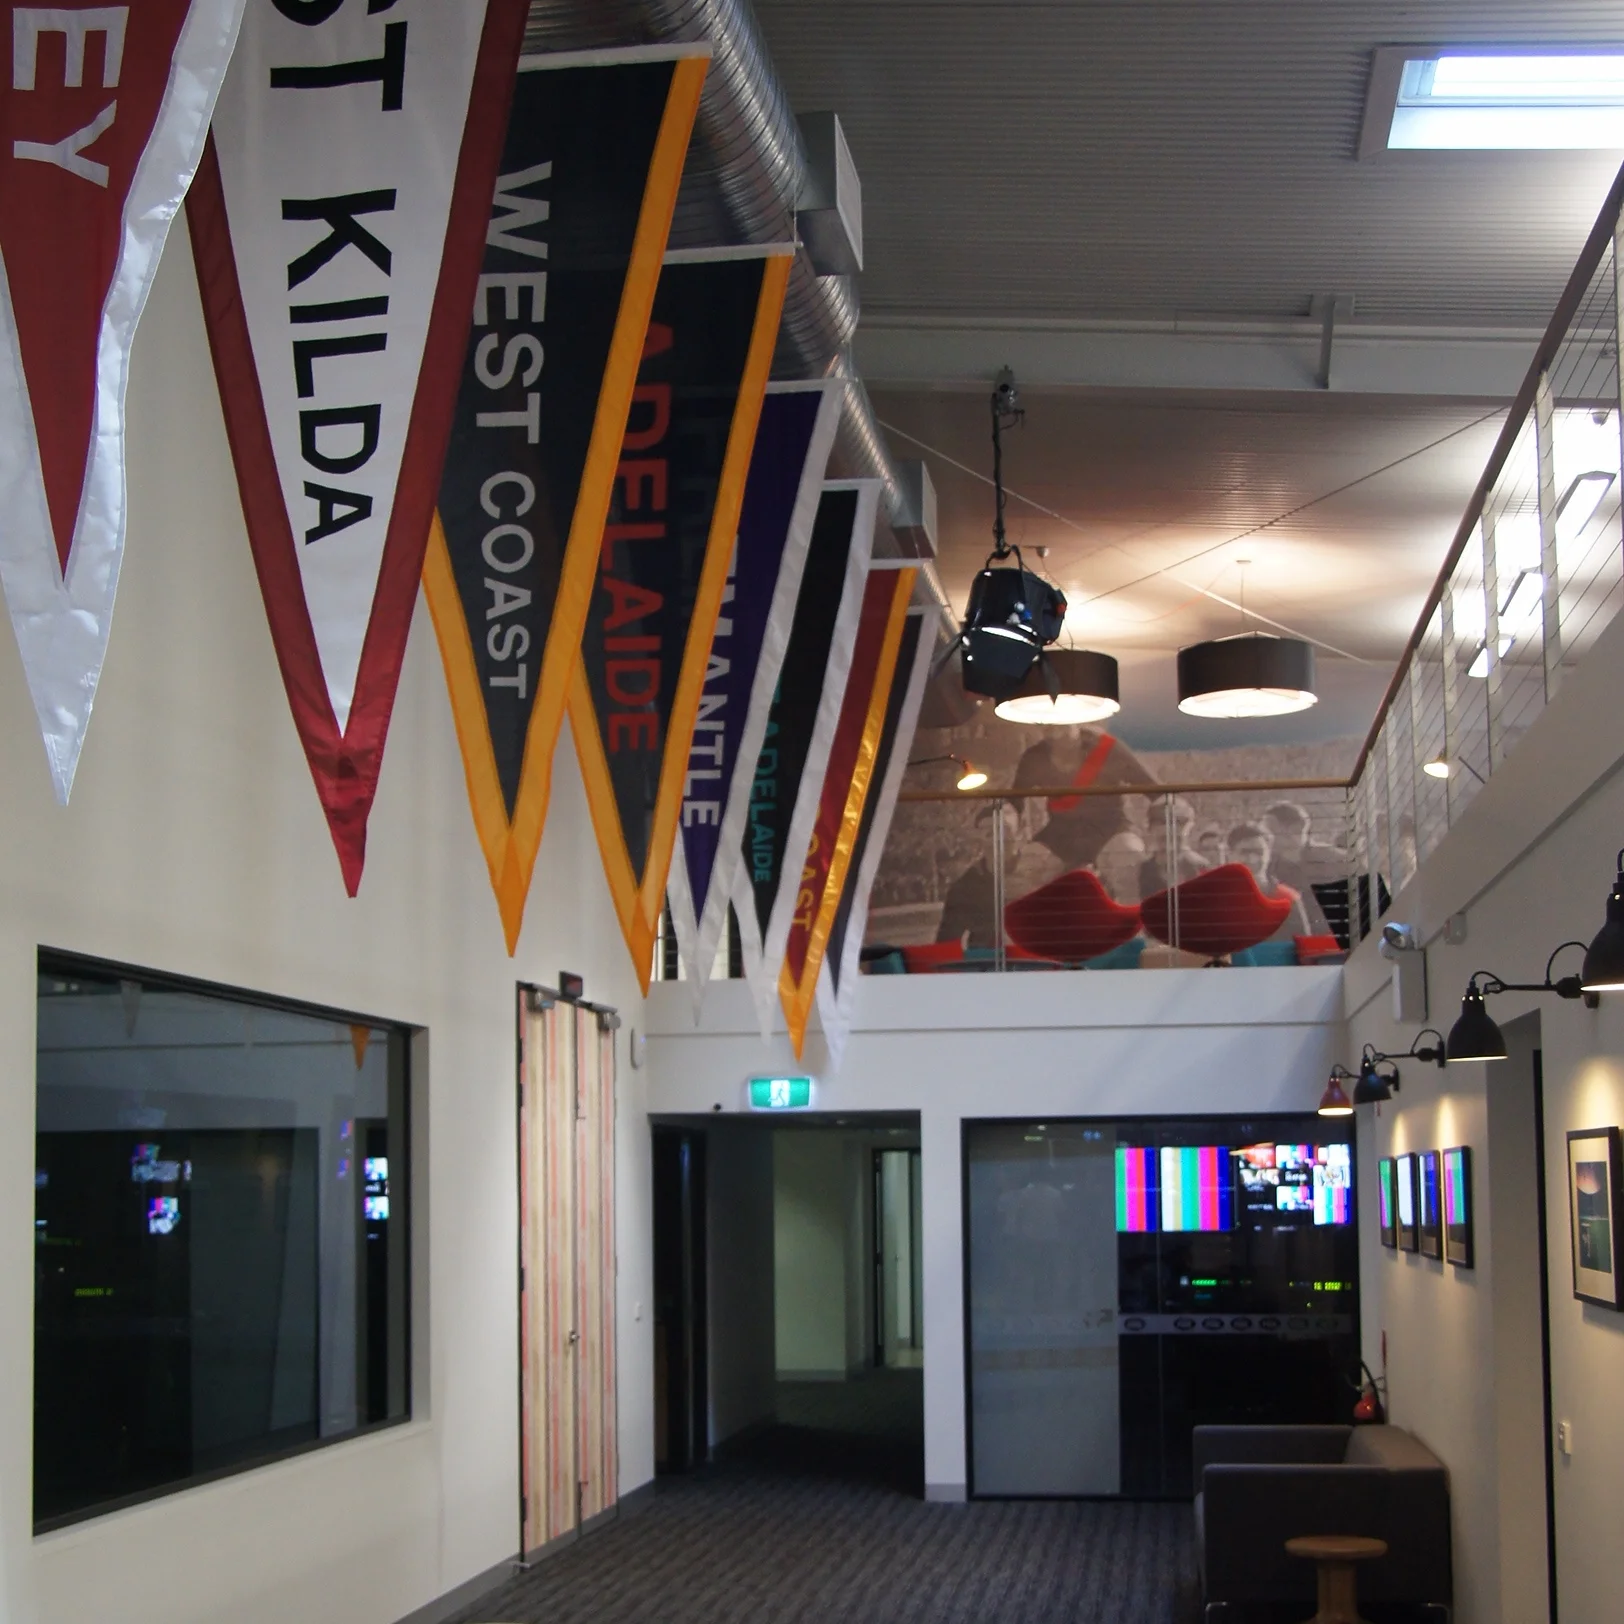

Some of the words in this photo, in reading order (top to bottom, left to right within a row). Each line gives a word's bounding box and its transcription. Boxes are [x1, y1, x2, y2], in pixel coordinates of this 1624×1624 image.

[281, 188, 398, 546] KILDA
[472, 160, 553, 444] WEST
[480, 470, 536, 699] COAST
